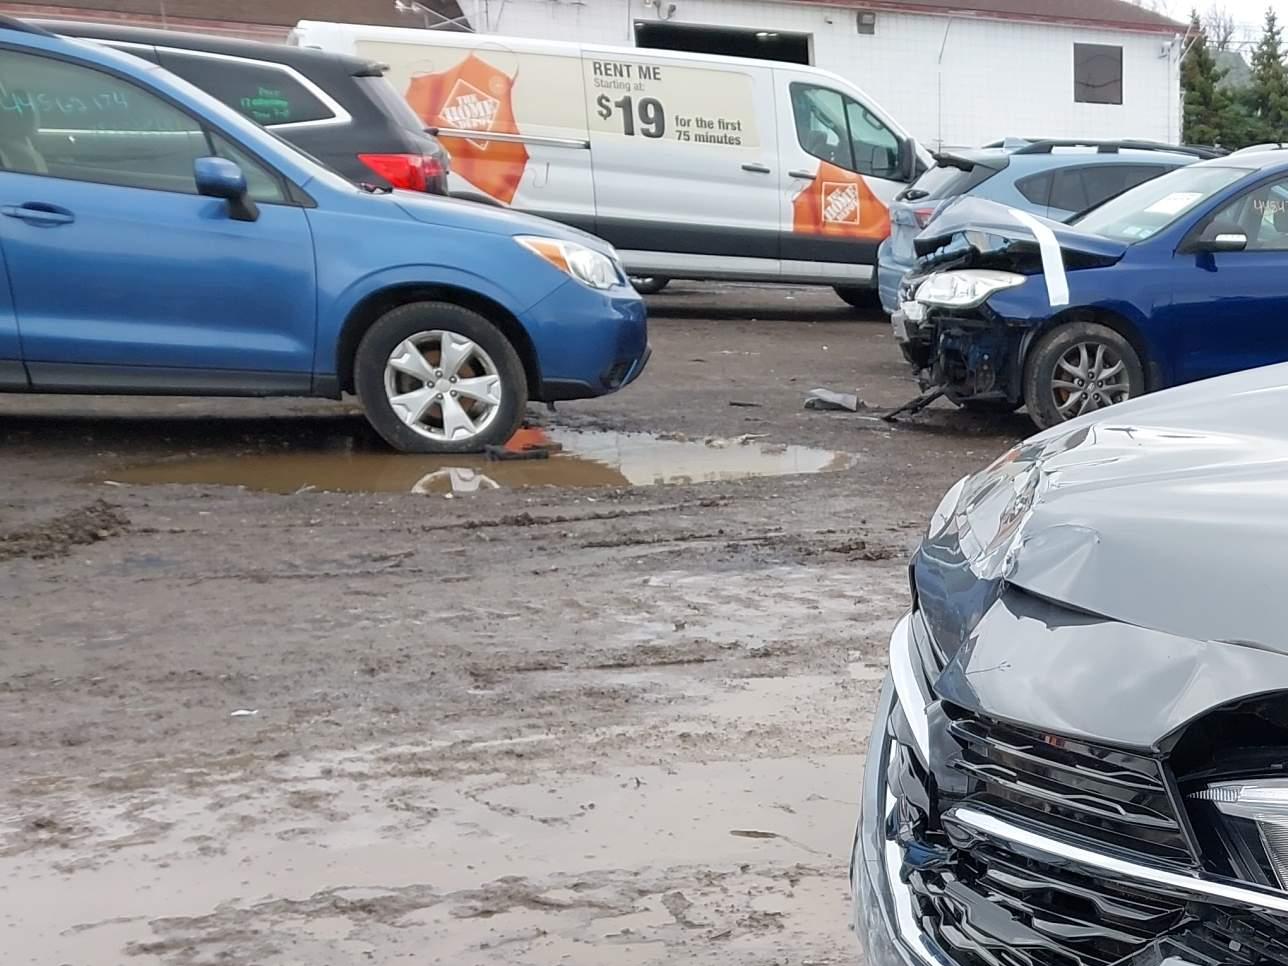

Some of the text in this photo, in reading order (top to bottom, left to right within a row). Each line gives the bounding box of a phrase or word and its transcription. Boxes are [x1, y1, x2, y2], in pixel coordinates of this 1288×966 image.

[593, 62, 662, 81] RENT ME
[594, 79, 645, 92] Starting at:
[456, 94, 478, 104] THE
[443, 99, 498, 121] HOME
[596, 93, 666, 139] $19
[675, 115, 741, 131] for the first
[675, 130, 741, 145] 75 minutes
[827, 188, 841, 201] THE
[824, 185, 856, 221] HOME
